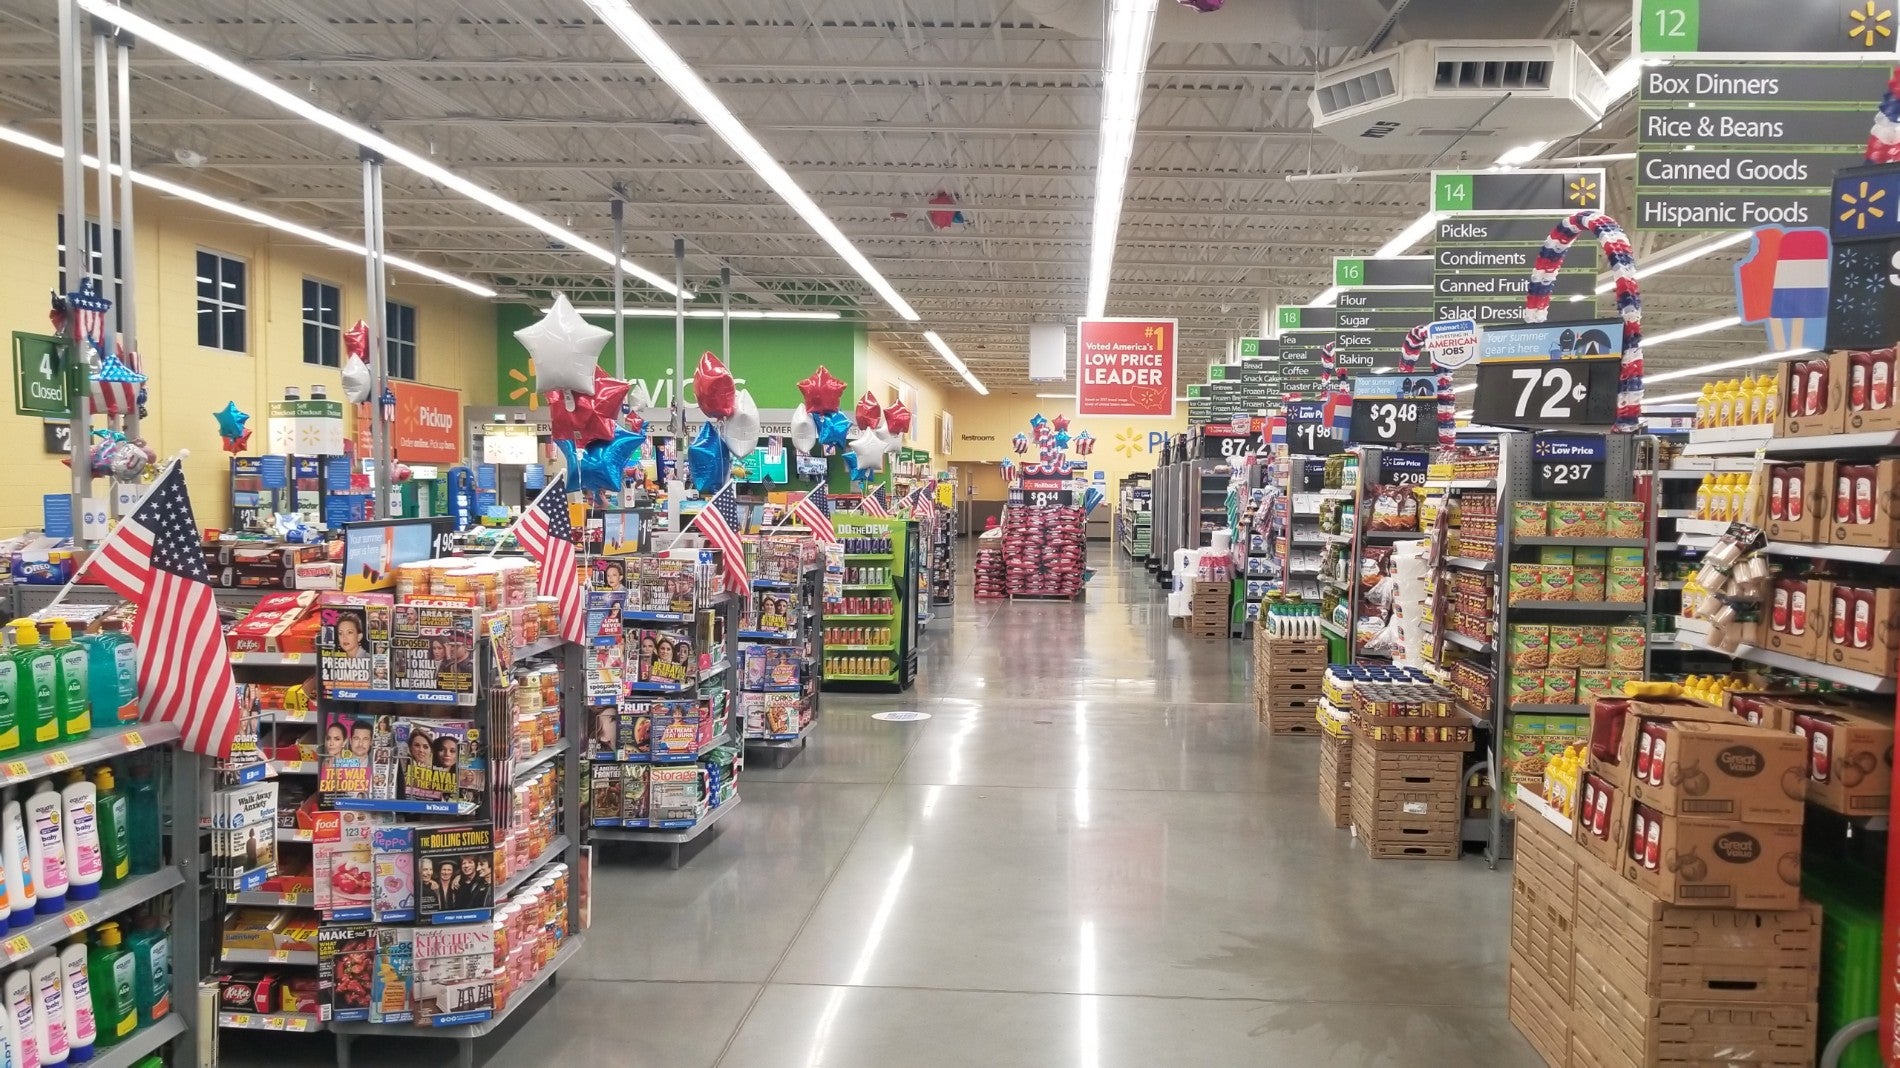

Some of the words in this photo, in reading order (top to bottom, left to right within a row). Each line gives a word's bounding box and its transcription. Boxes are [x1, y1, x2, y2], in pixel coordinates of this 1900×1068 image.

[1655, 9, 1686, 37] 12
[1649, 73, 1690, 94] Box
[1696, 73, 1779, 95] Dinners
[1648, 116, 1692, 137] Rice
[1697, 116, 1715, 137] &
[1720, 117, 1784, 138] Beans
[1645, 158, 1730, 180] Canned
[1736, 159, 1808, 181] Goods
[1444, 183, 1466, 202] 14
[1645, 201, 1737, 227] Hispanic
[1742, 202, 1809, 223] Foods
[1441, 223, 1488, 238] Pickles
[1440, 251, 1526, 266] Condiments
[1342, 265, 1359, 279] 16
[1440, 278, 1495, 293] Canned
[1340, 295, 1367, 306] Flour
[1283, 312, 1297, 323] 18
[1439, 305, 1478, 321] Salad
[1481, 306, 1526, 320] Dressi
[1340, 314, 1370, 328] Sugar
[1434, 324, 1461, 332] Walmart
[1282, 336, 1297, 344] Tea
[1339, 335, 1372, 348] Spices
[1428, 337, 1478, 349] AMERICAN
[1487, 334, 1508, 343] Your
[1509, 332, 1549, 342] summer
[1086, 342, 1111, 351] Voted
[1112, 342, 1154, 351] America's
[1243, 343, 1256, 352] 20
[1441, 346, 1465, 357] JOBS
[1485, 345, 1507, 357] gear
[1508, 344, 1517, 354] is
[1517, 343, 1540, 353] here
[1084, 353, 1118, 366] LOW
[1121, 353, 1163, 367] PRICE
[1282, 351, 1308, 360] Cereal
[1339, 354, 1374, 368] Baking
[39, 353, 53, 380] 4
[1243, 362, 1263, 370] Bread
[1282, 366, 1309, 376] Coffee
[1084, 368, 1163, 386] LEADER
[1243, 374, 1262, 382] Snack
[31, 381, 63, 401] Closed
[1282, 382, 1310, 392] Toaster
[1512, 367, 1588, 419] 72¢
[420, 406, 453, 433] Pickup
[400, 437, 413, 447] Order
[961, 434, 995, 442] Restrooms
[1551, 446, 1570, 455] Low
[1571, 446, 1594, 456] Price
[838, 524, 852, 535] DO
[866, 524, 889, 535] DEW
[23, 562, 51, 576] OREO
[346, 595, 370, 605] Star
[410, 599, 469, 608] GLOBE
[395, 639, 429, 648] EXPOSED!
[321, 657, 371, 670] PREGNANT
[418, 659, 436, 670] KILL
[322, 669, 330, 680] &
[68, 684, 81, 692] Aloe
[395, 678, 401, 688] &
[401, 678, 437, 689] MEGHAN
[337, 690, 359, 698] Star
[417, 693, 454, 701] GLOBE
[617, 702, 651, 712] FRUIT
[1721, 751, 1757, 766] Great
[326, 768, 344, 780] THE
[345, 767, 366, 780] WAR
[1729, 762, 1756, 773] Value
[651, 770, 697, 783] Storage
[319, 779, 369, 792] EXPLODES!
[238, 795, 255, 806] Walk
[256, 791, 272, 801] Away
[243, 800, 267, 813] Anxiety
[75, 823, 91, 832] baby
[314, 818, 339, 832] food
[41, 833, 57, 842] baby
[345, 827, 359, 837] 123
[374, 832, 406, 848] Peppa
[421, 836, 431, 848] THE
[430, 831, 461, 848] ROLLING
[462, 830, 490, 846] STONES
[1718, 838, 1753, 851] Great
[1726, 848, 1752, 858] Value
[319, 930, 355, 942] MAKE
[416, 931, 490, 948] KITCHENS
[415, 949, 425, 959] &
[427, 945, 465, 957] BATHS
[226, 986, 250, 998] KitKat
